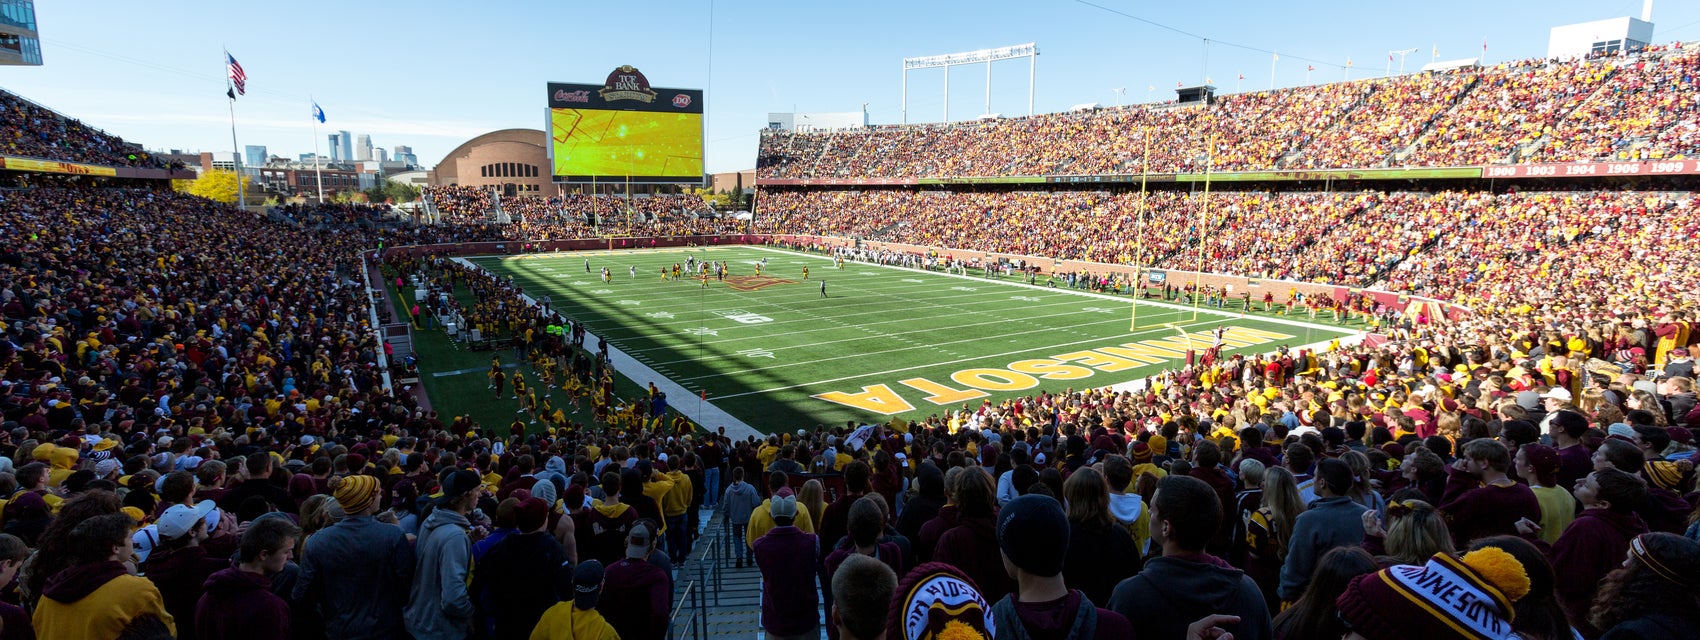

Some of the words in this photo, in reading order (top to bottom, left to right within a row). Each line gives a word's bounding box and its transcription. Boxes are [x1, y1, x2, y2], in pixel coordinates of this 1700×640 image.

[618, 74, 638, 84] TCF
[615, 82, 641, 91] BANK
[1488, 167, 1517, 177] 1900
[1525, 166, 1556, 176] 1903
[1565, 165, 1596, 175] 1904
[1607, 164, 1640, 174] 1906
[1651, 162, 1684, 173] 1909
[808, 325, 1298, 415] MINNESOTA
